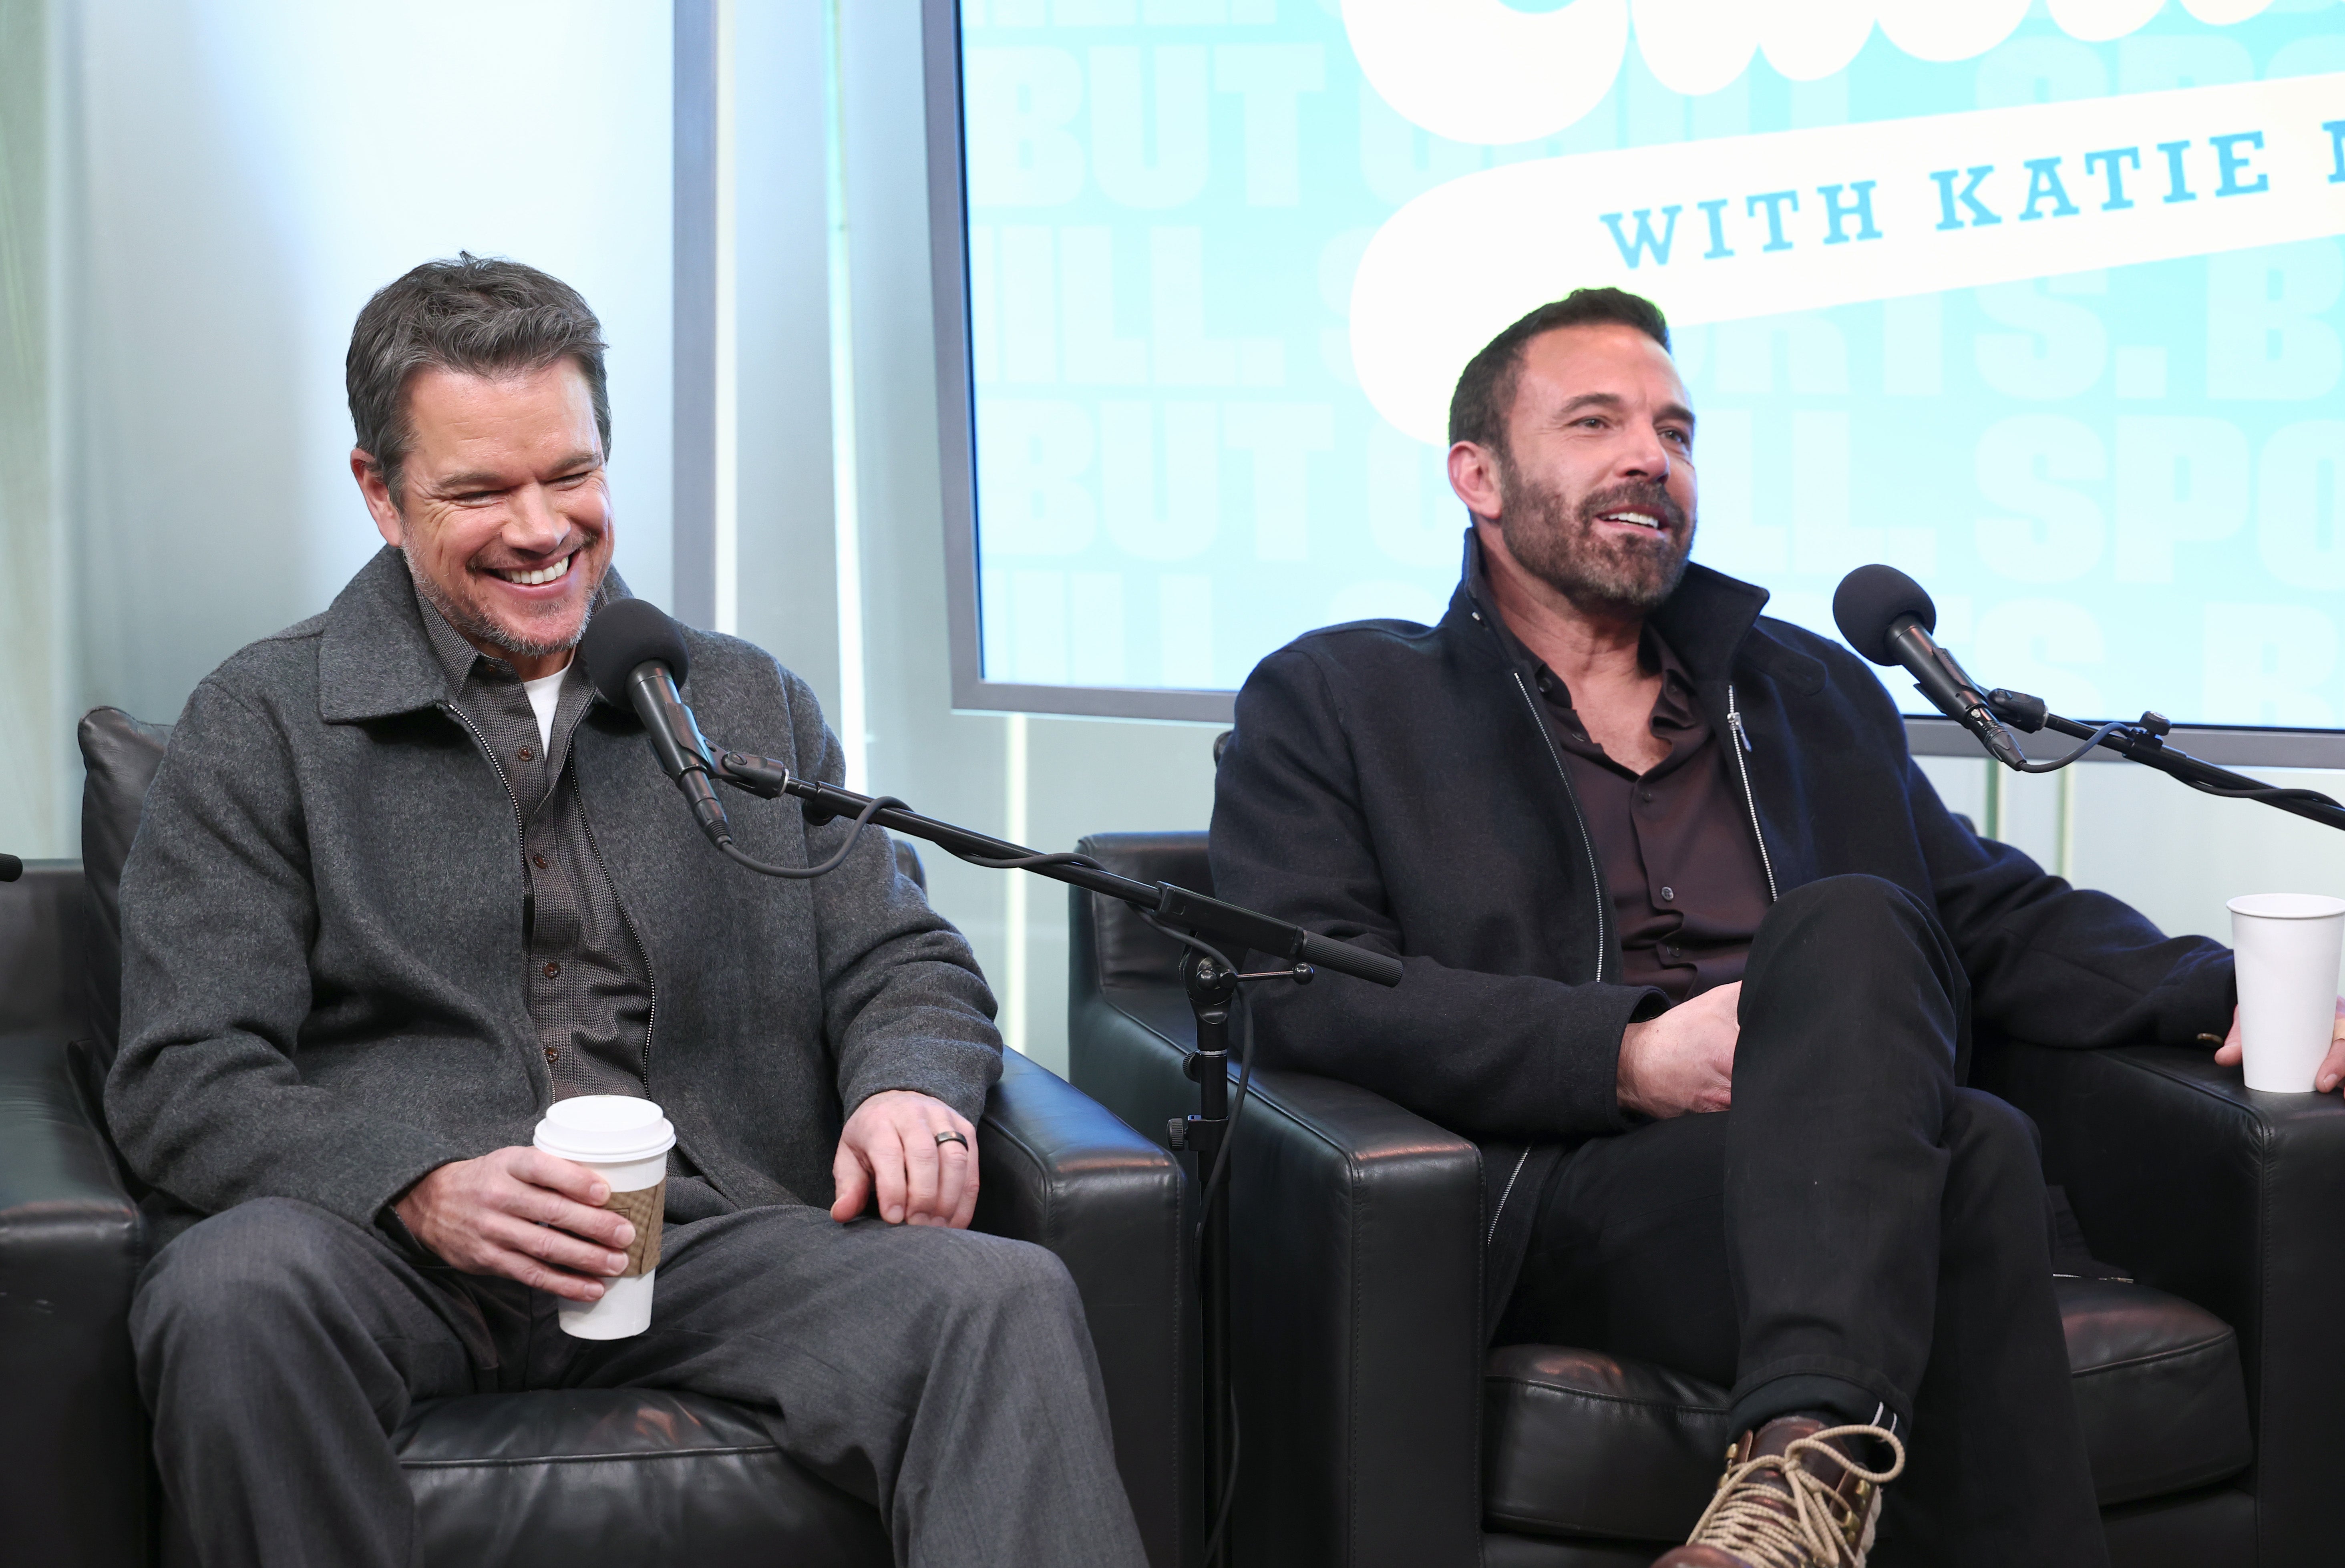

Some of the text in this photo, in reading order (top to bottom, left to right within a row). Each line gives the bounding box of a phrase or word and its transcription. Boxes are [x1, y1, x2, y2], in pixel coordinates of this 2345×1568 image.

[968, 44, 1326, 209] BUT
[1599, 179, 1884, 269] WITH
[1929, 130, 2270, 231] KATIE
[973, 225, 1285, 386] ILL.
[981, 399, 1335, 561] BUT
